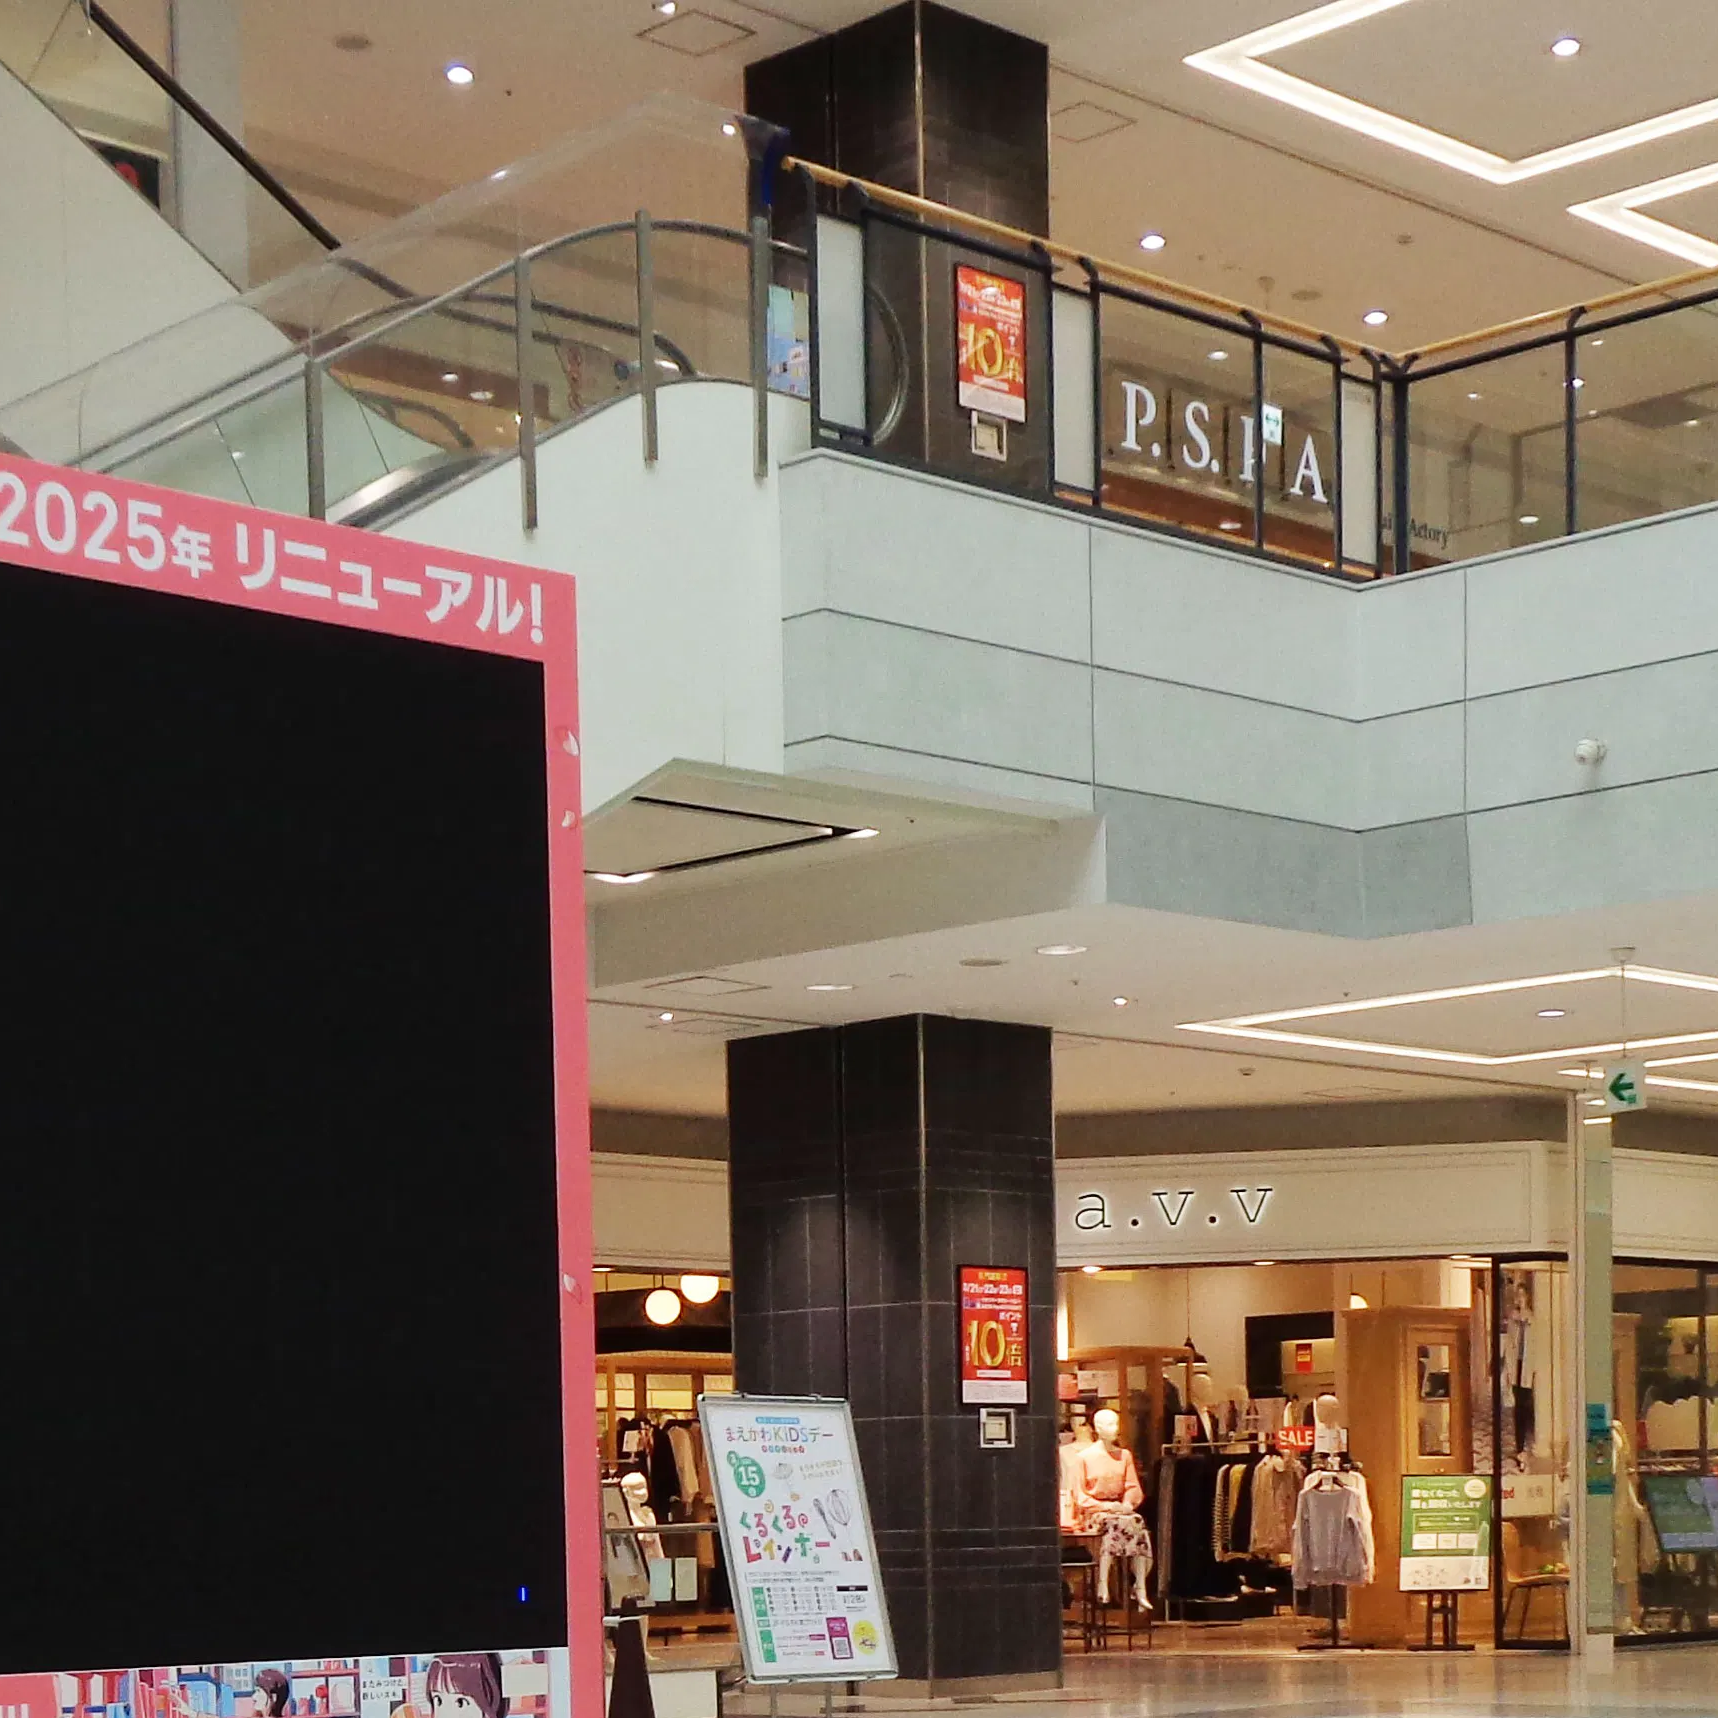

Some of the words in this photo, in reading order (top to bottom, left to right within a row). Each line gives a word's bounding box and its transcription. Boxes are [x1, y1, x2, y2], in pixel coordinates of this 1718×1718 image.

[234, 521, 546, 645] リニューアル!
[1075, 1187, 1273, 1230] a.v.v
[1278, 1430, 1314, 1446] SALE
[738, 1466, 760, 1486] 15
